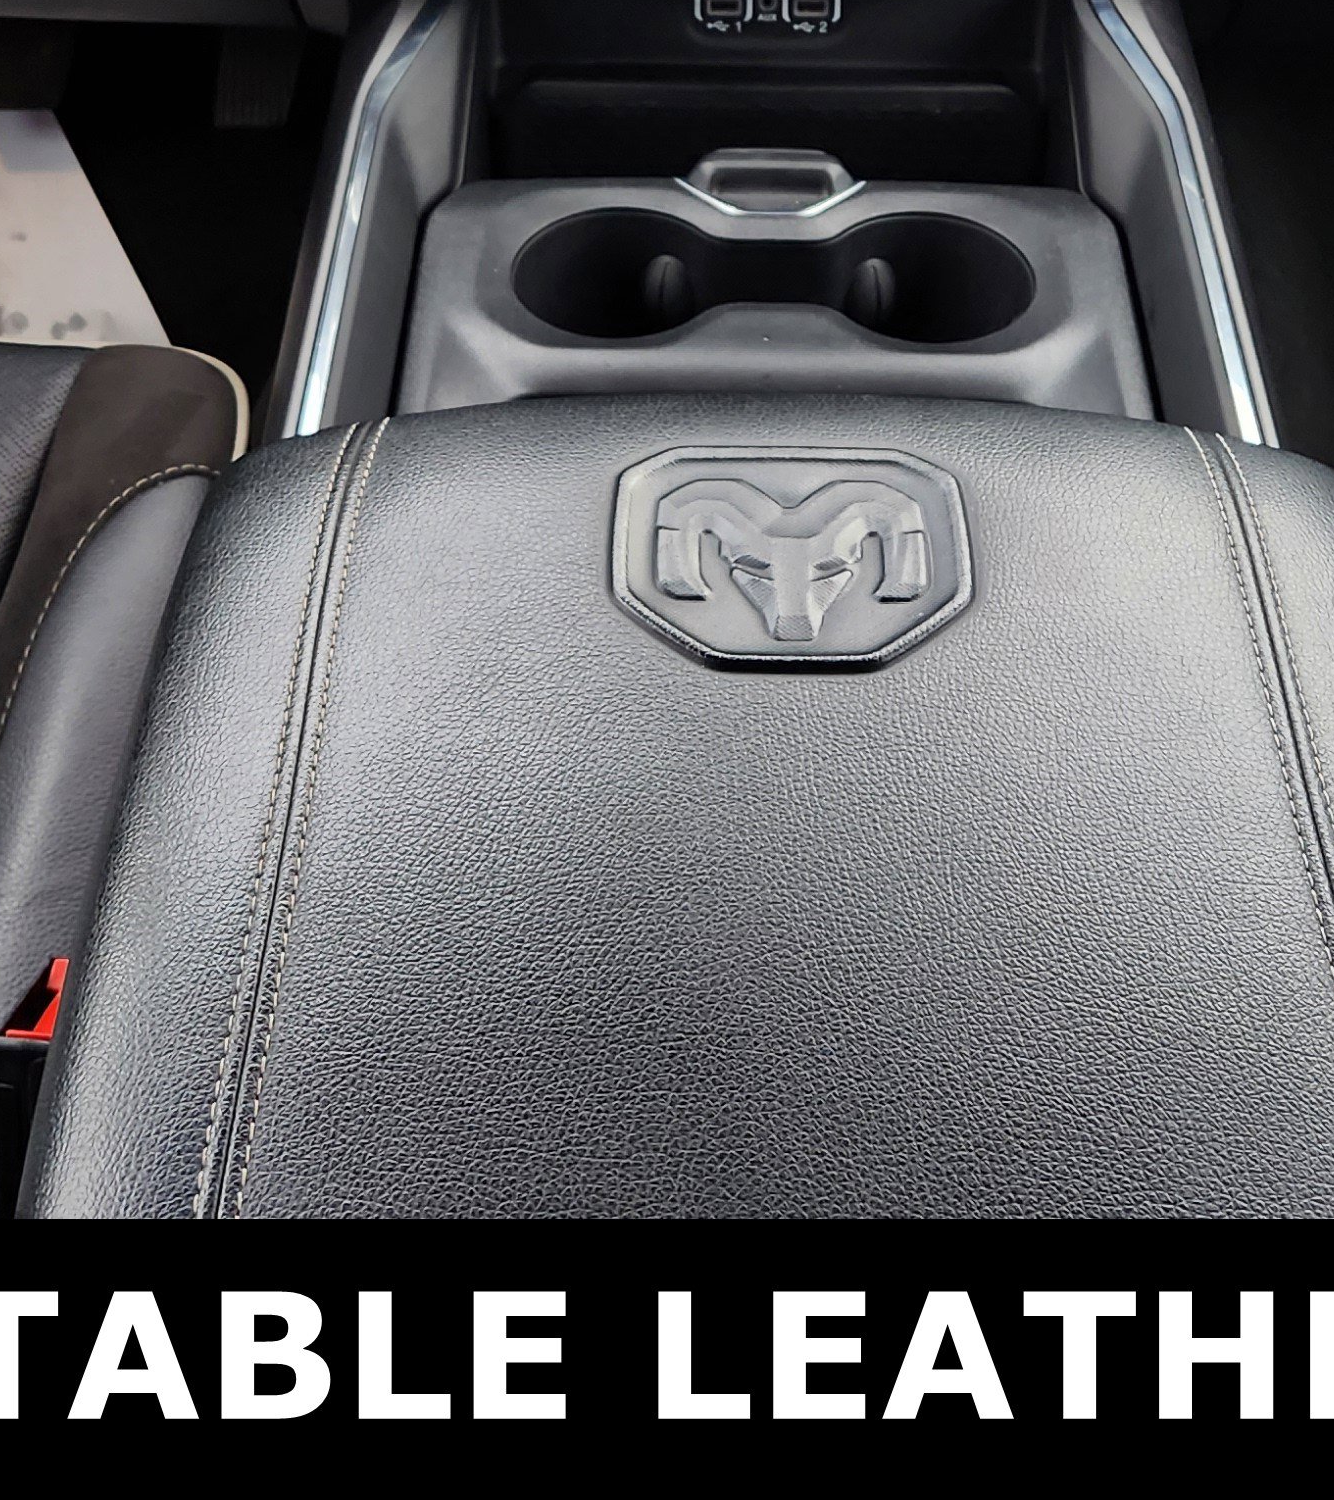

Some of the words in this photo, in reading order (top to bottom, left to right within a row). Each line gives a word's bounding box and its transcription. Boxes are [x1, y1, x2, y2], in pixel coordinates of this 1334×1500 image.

[757, 13, 778, 21] AUX
[735, 21, 742, 32] 1
[819, 21, 828, 33] 2
